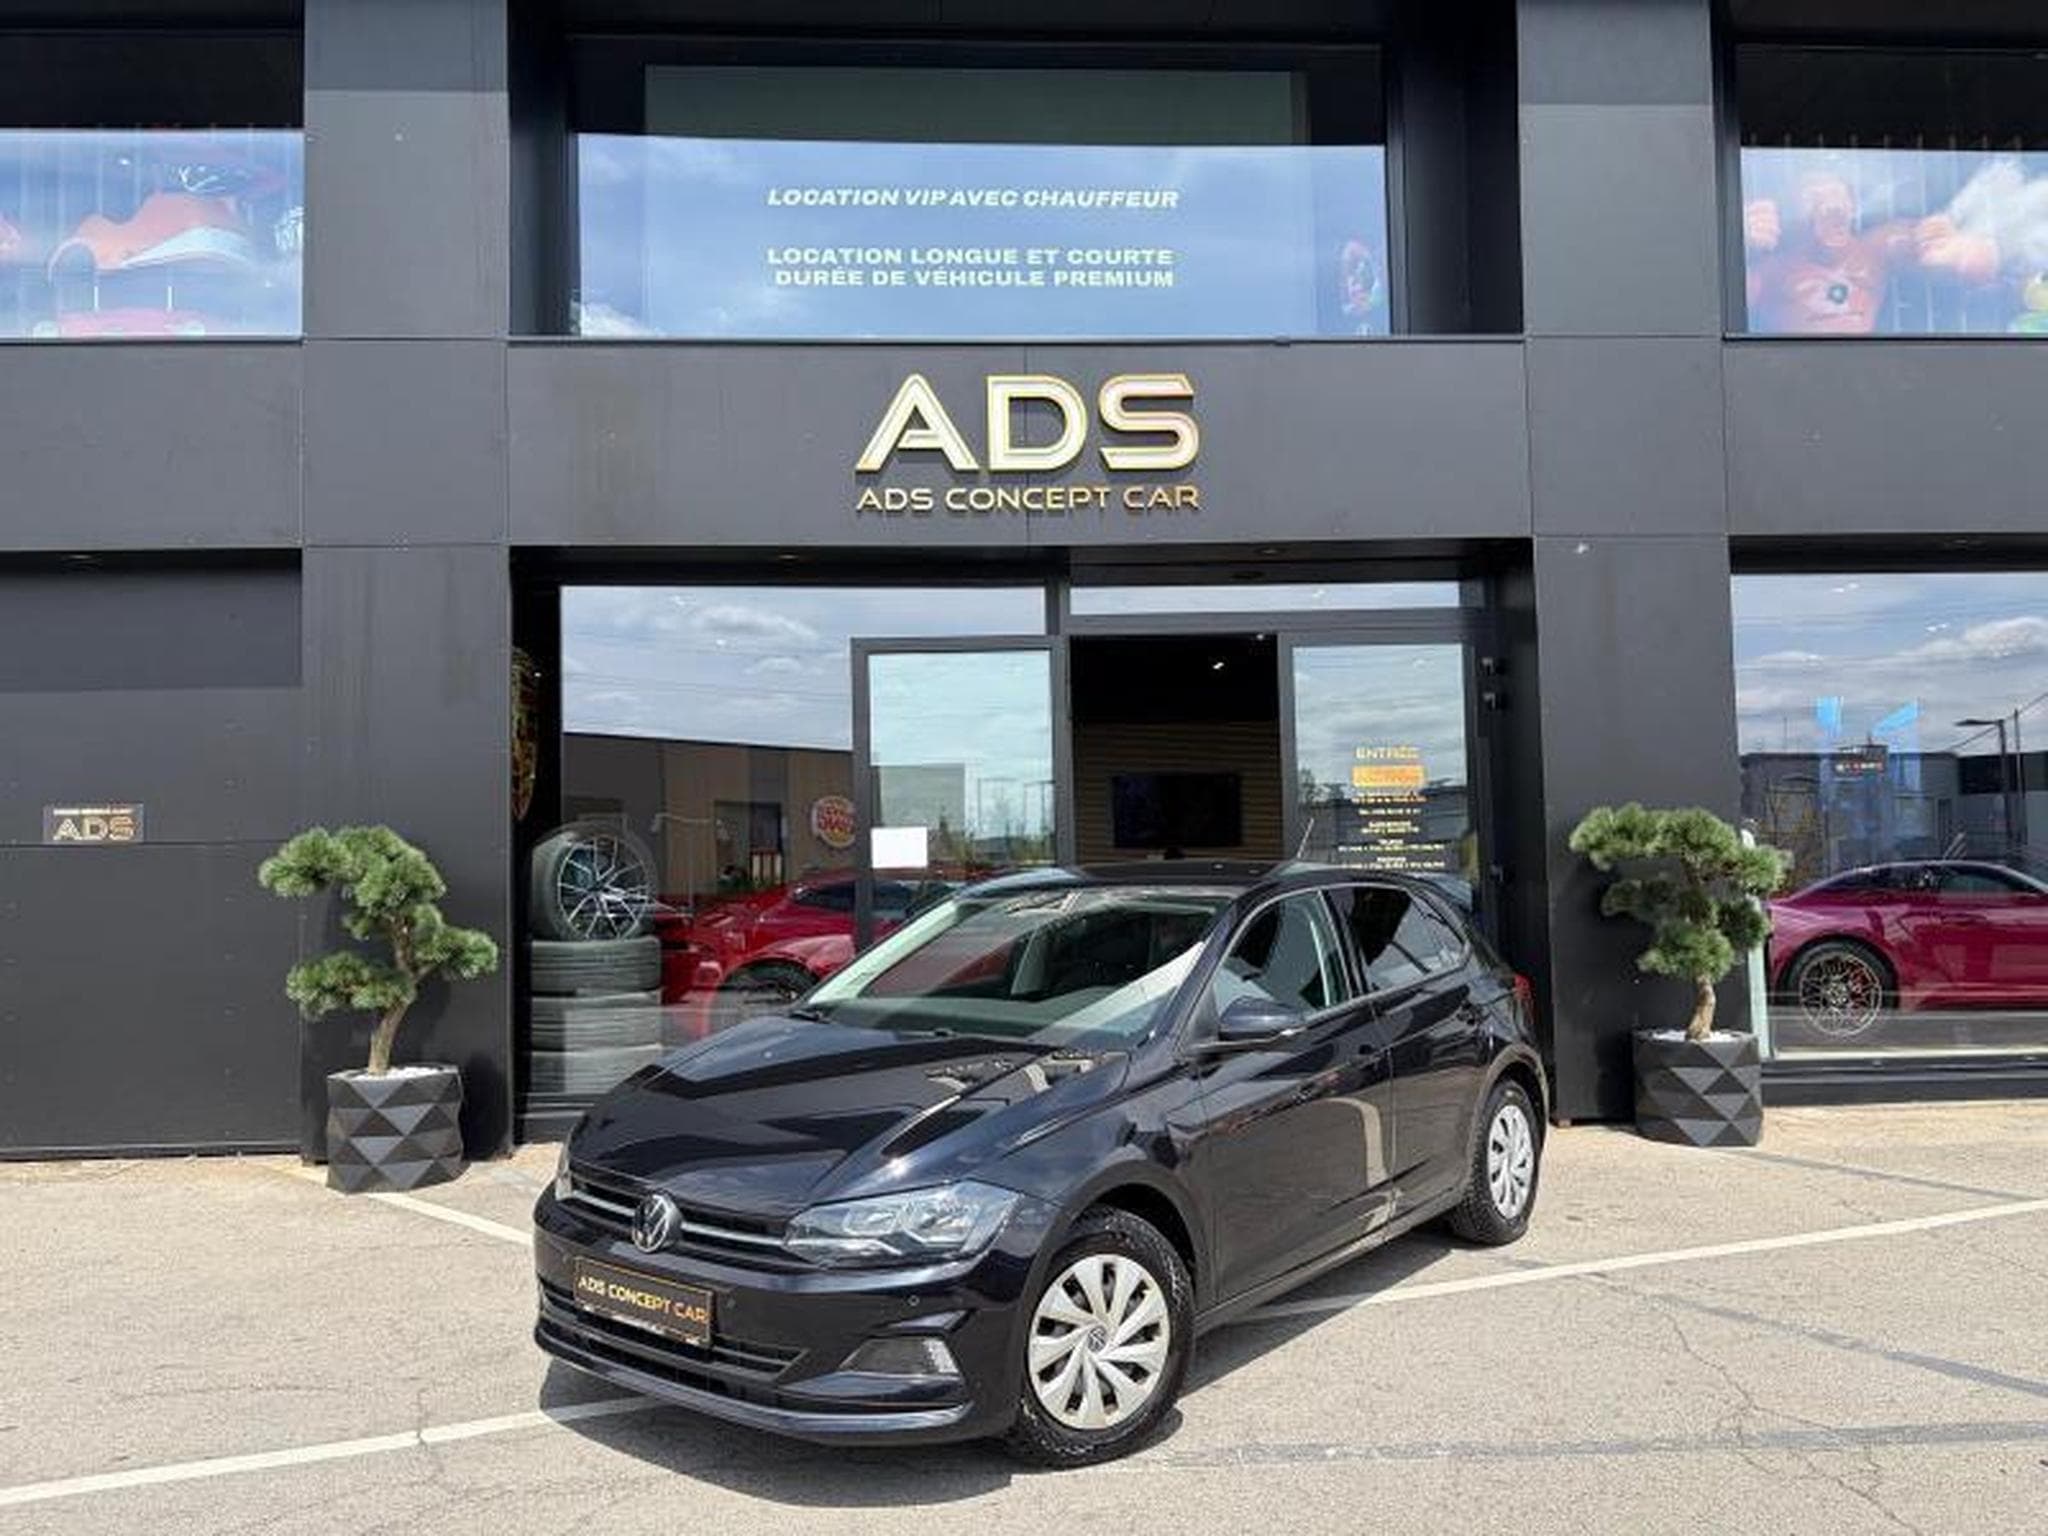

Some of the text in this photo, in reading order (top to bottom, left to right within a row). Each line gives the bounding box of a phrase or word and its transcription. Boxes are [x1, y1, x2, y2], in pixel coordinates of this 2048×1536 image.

[767, 189, 1179, 209] LOCATION VIP AVEC CHAUFFEUR
[767, 247, 1175, 266] LOCATION LONGUE ET COURTE
[775, 266, 1175, 288] DURÉE DE VÉHICULE PREMIUM
[855, 373, 1200, 471] ADS
[856, 486, 1202, 512] ADS CONCEPT CAR
[52, 815, 135, 841] ADS
[577, 1276, 711, 1325] ADS CONCEPT CAR
